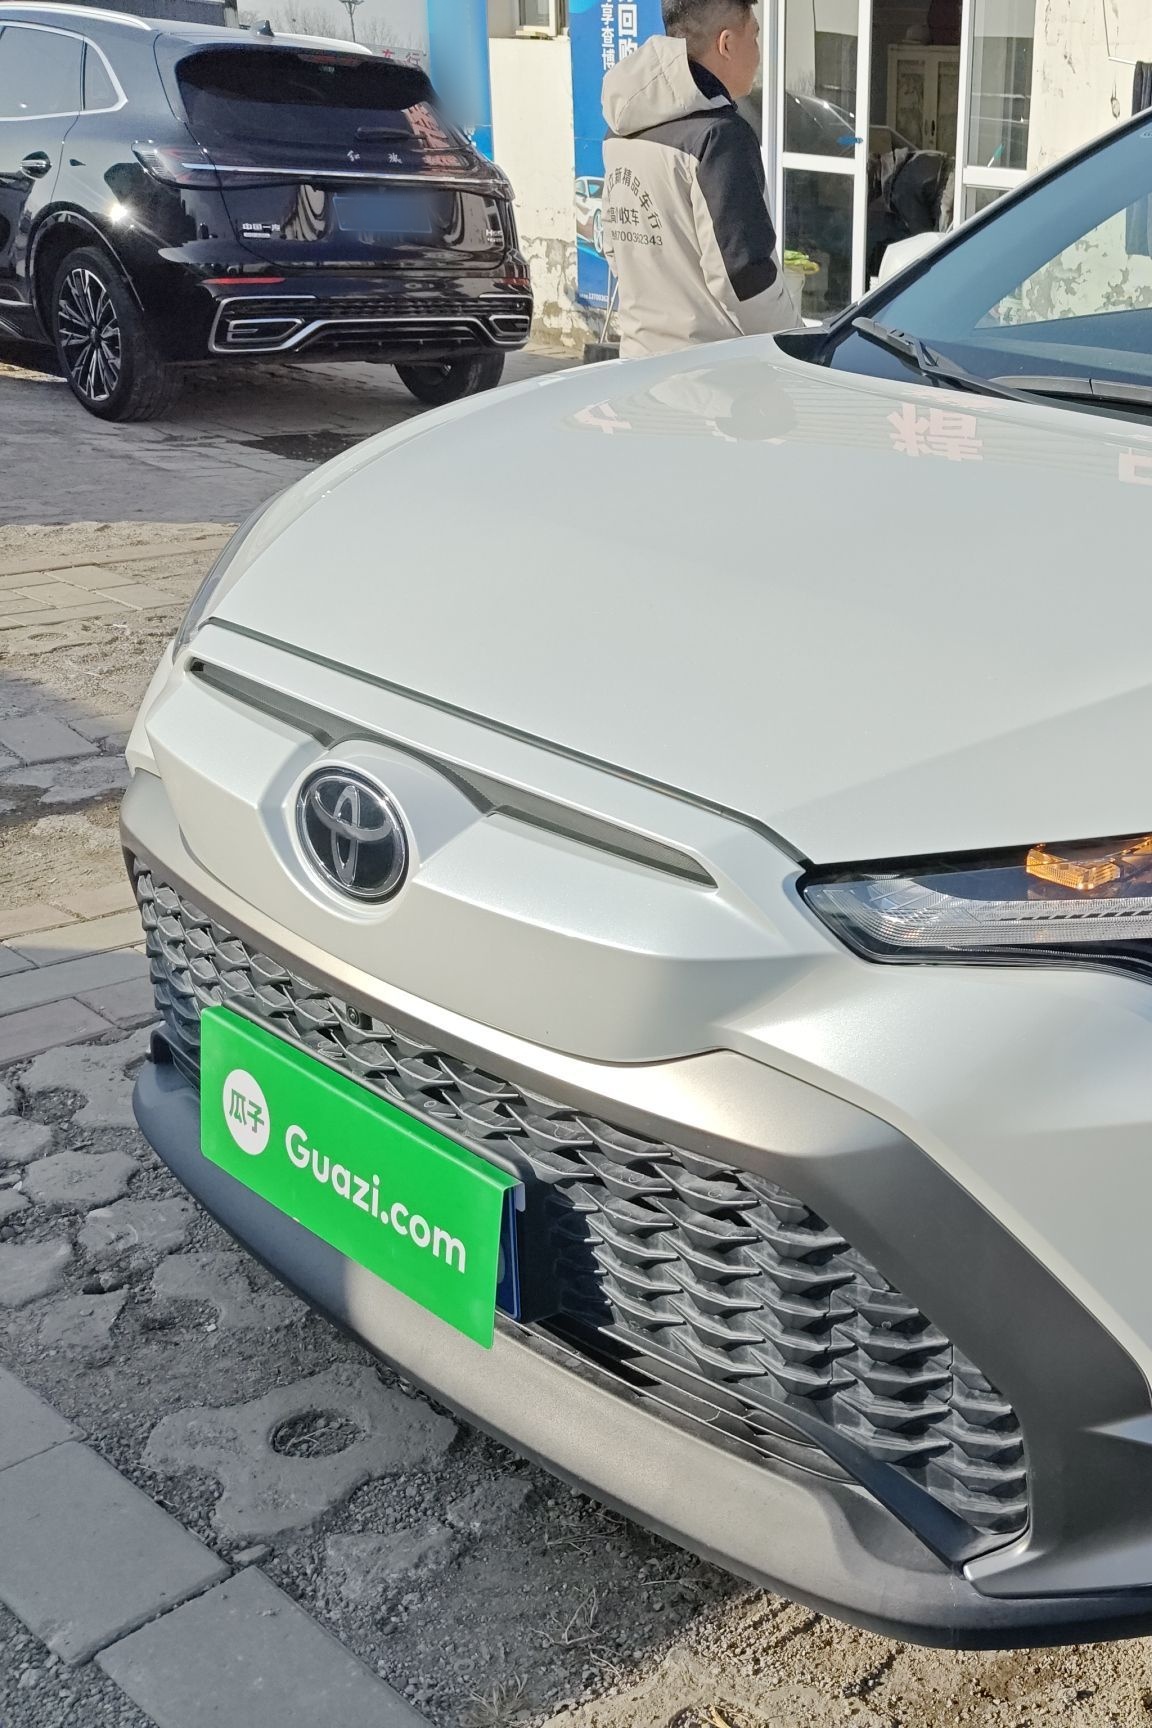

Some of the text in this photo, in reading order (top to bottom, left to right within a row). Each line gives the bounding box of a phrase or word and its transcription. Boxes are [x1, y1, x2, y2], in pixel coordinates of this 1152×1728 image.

[600, 0, 616, 71] 享查博
[617, 0, 638, 62] 回购
[228, 1087, 265, 1134] 瓜子
[284, 1124, 466, 1274] Guazi.com
